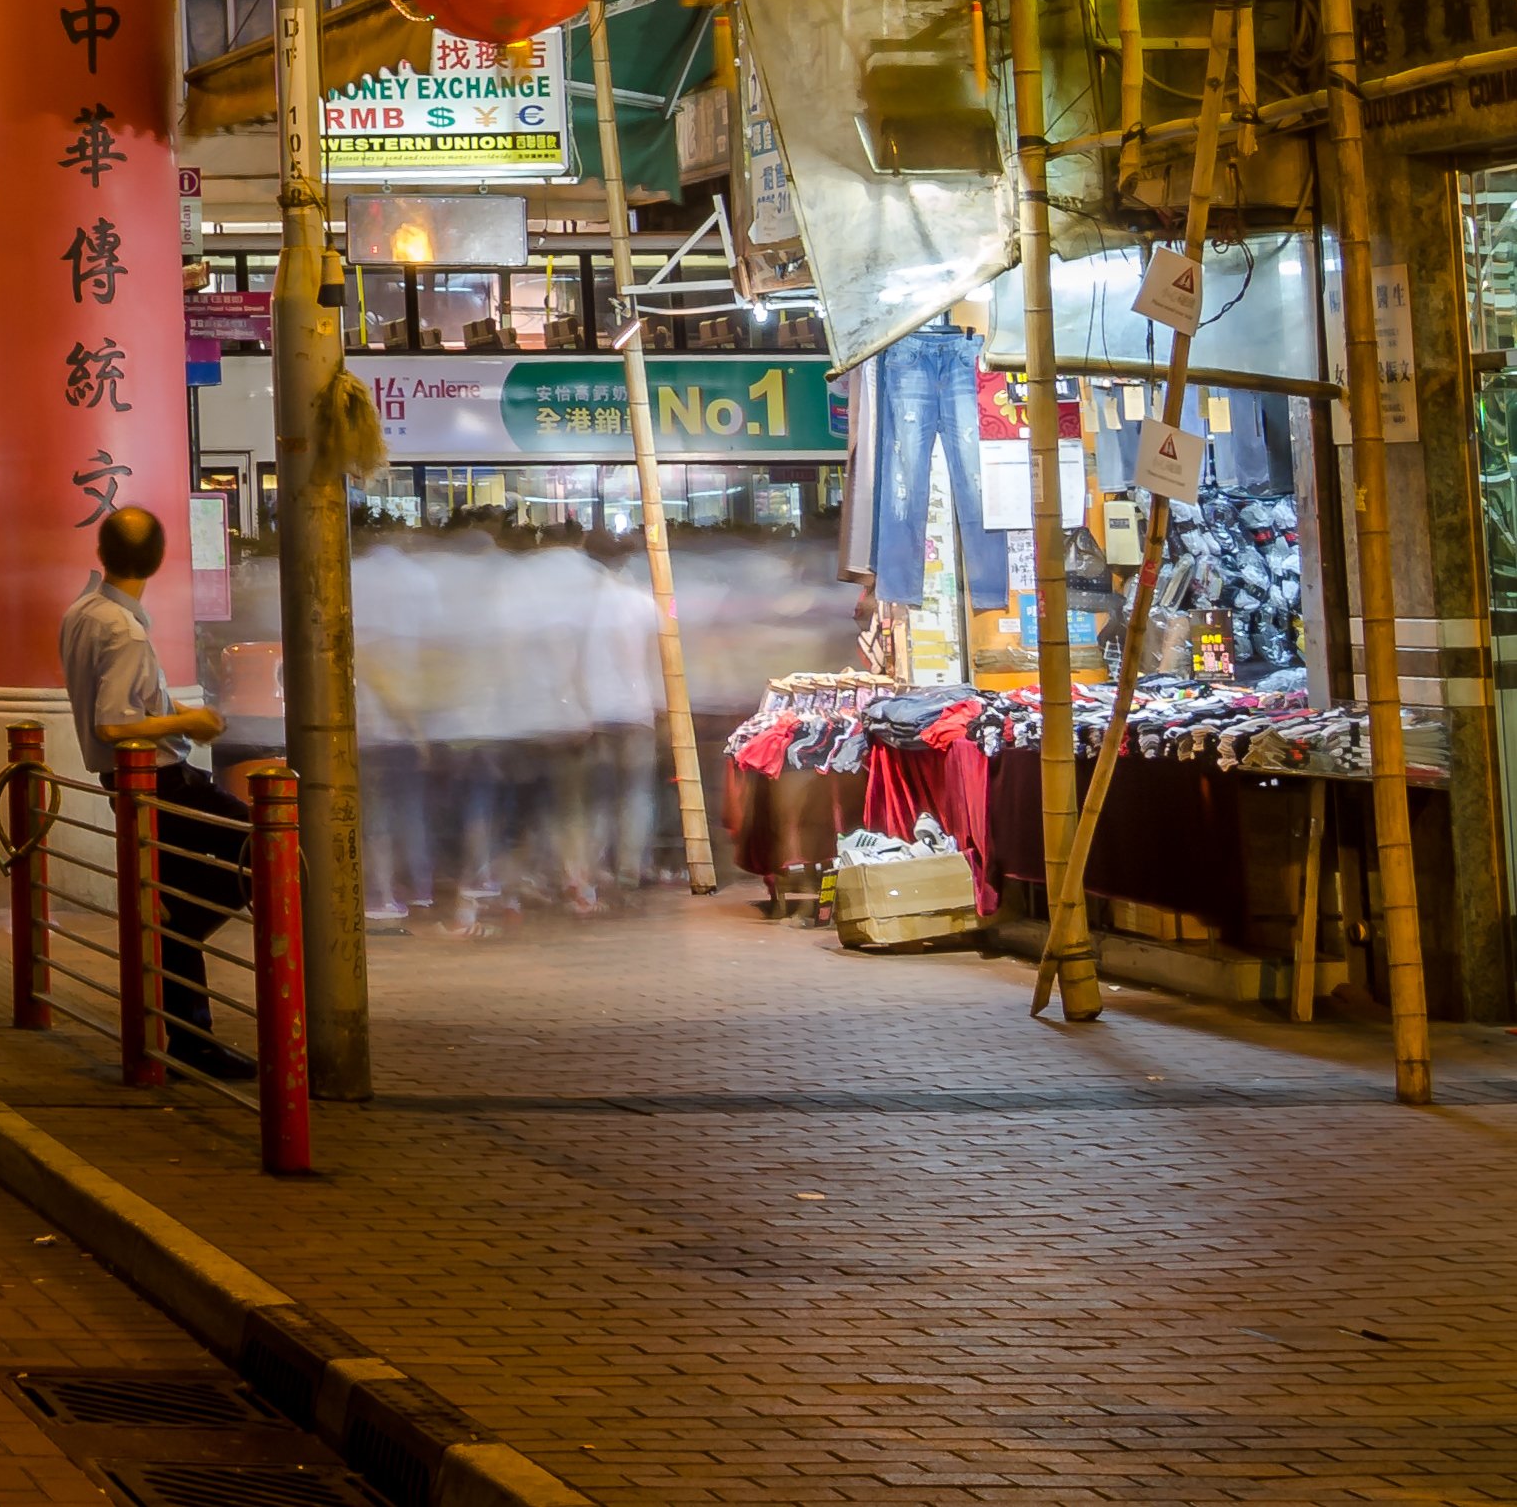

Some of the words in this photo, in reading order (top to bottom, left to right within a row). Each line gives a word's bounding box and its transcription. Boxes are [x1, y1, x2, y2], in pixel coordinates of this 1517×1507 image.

[417, 75, 551, 99] EXCHANGE
[326, 107, 405, 129] RMB
[437, 135, 512, 150] UNION
[181, 204, 193, 245] Jordan
[412, 379, 481, 399] Anlene
[659, 368, 788, 438] No.1
[535, 407, 630, 436] 全港銷
